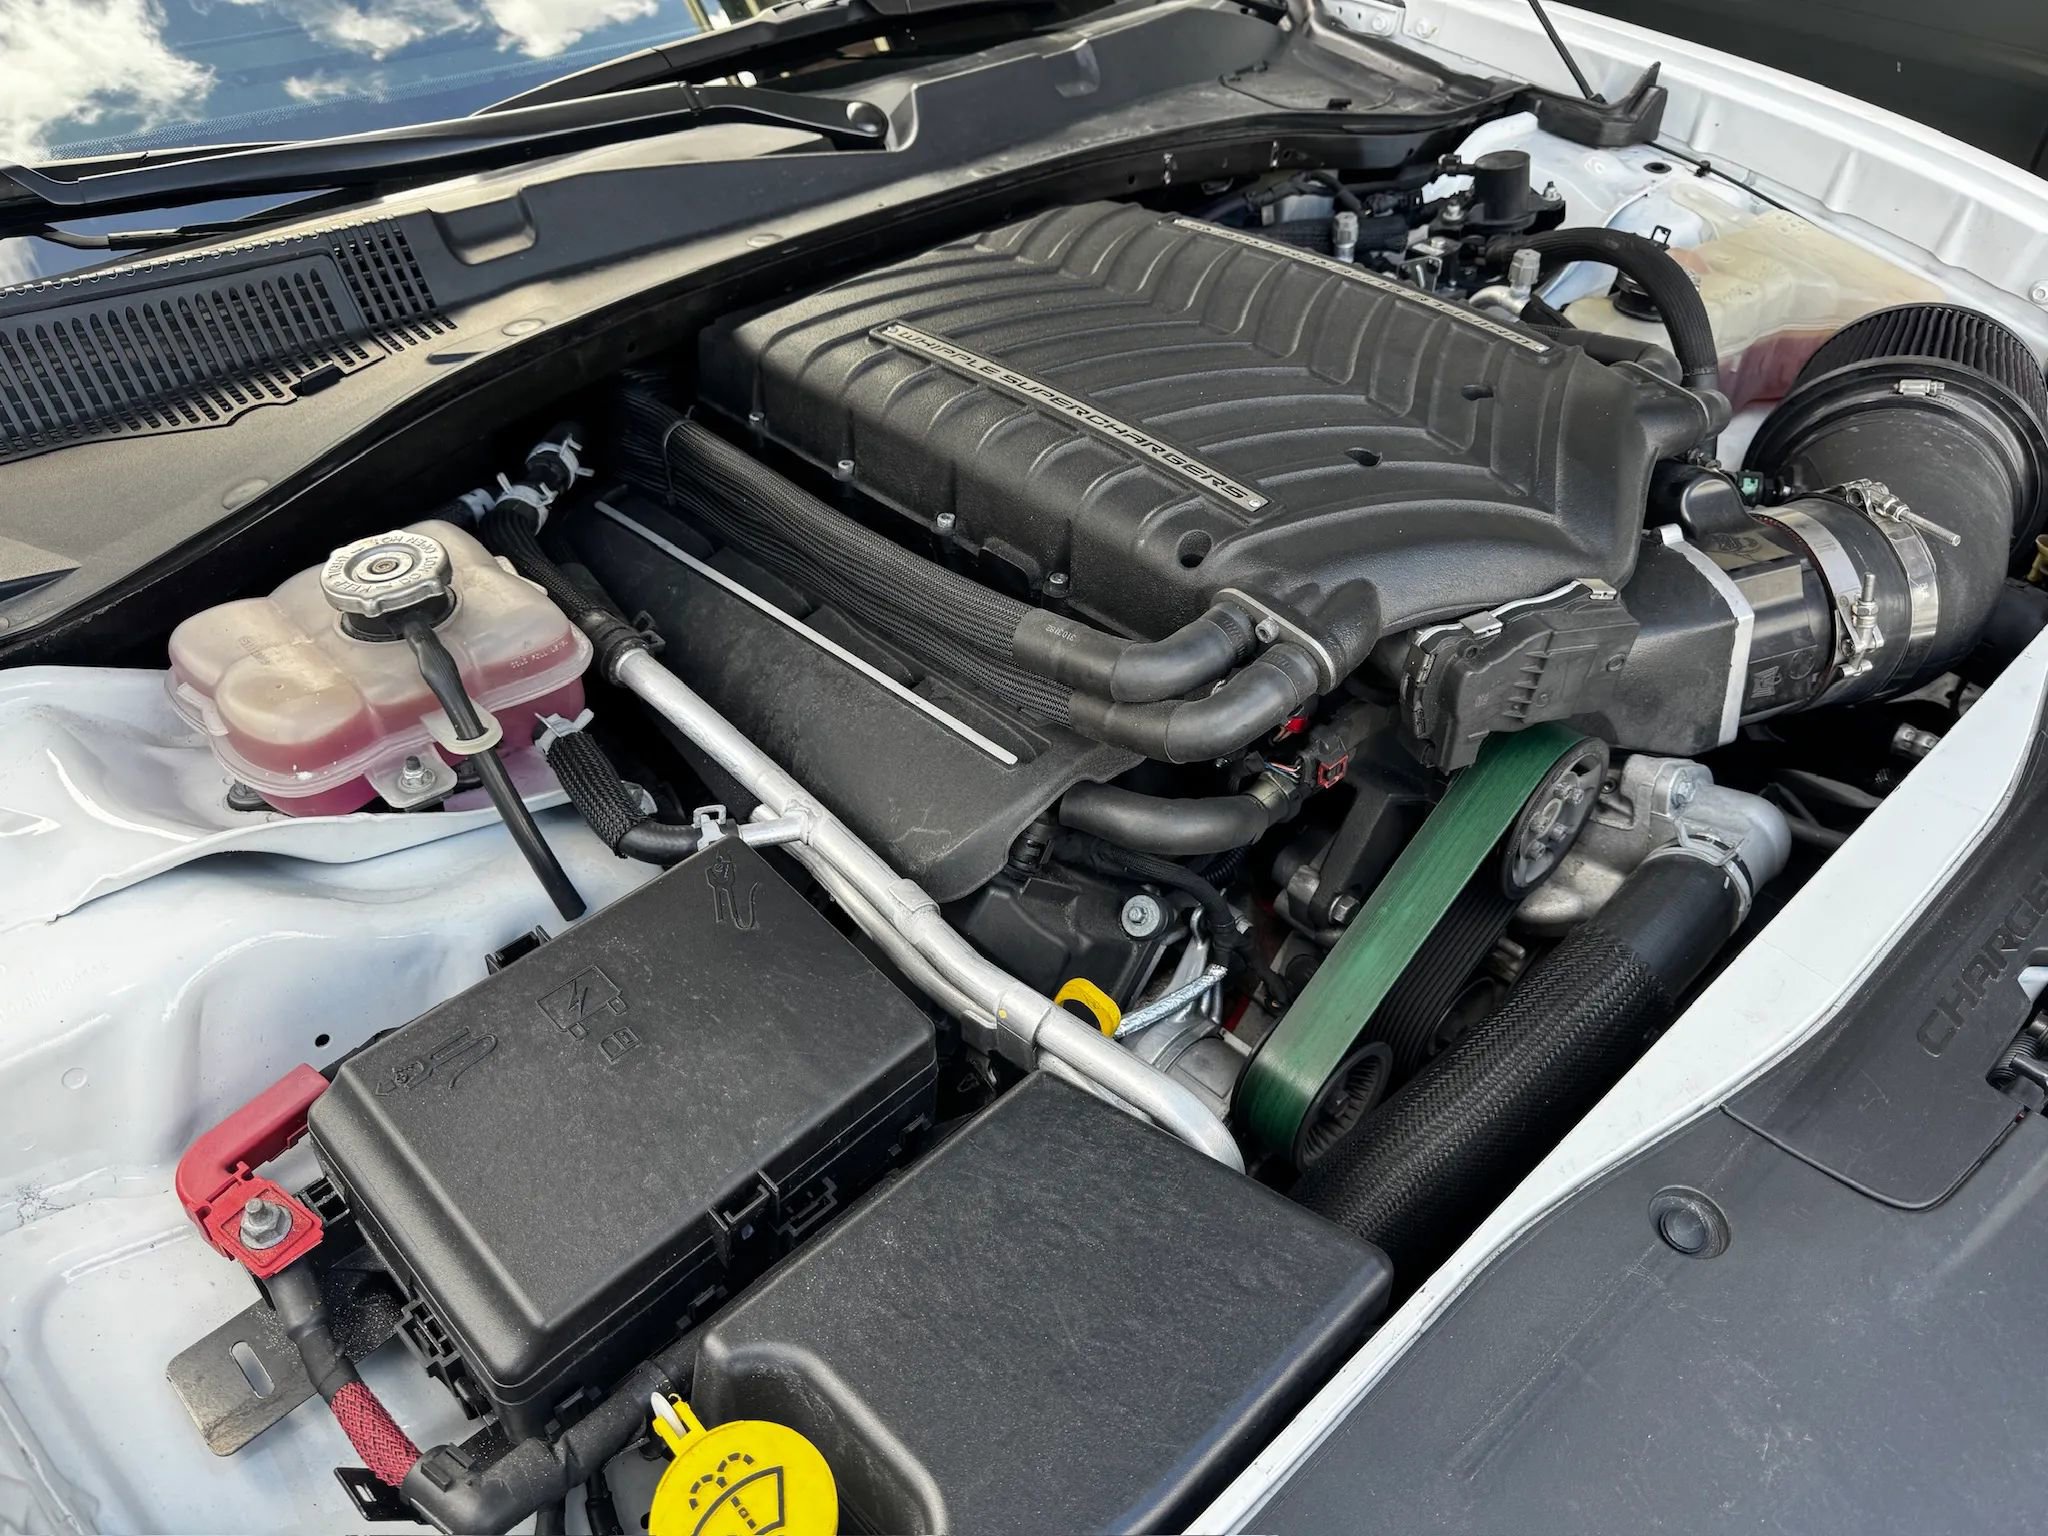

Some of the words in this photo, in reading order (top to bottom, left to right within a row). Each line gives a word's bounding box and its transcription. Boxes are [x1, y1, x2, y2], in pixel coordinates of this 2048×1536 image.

[899, 331, 1000, 375] WHIPPLE
[1002, 373, 1248, 500] SUPERCHARGERS
[334, 580, 372, 593] KEEP
